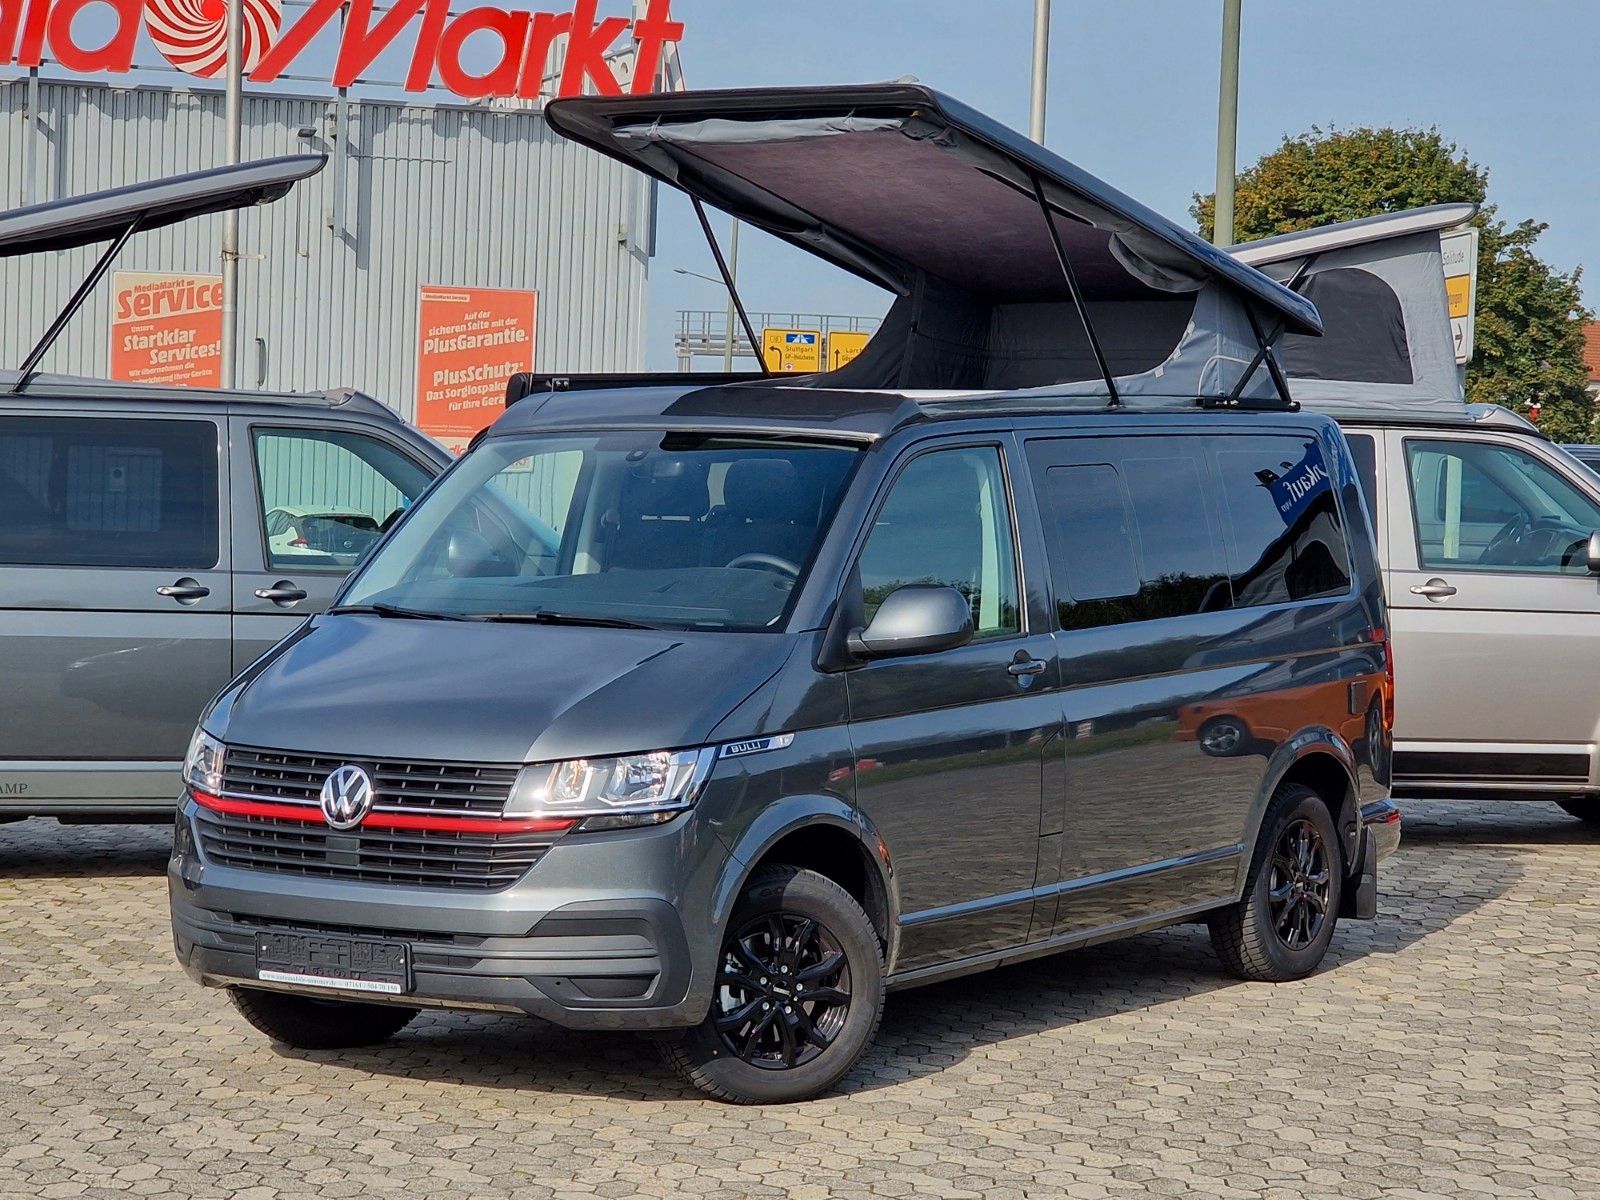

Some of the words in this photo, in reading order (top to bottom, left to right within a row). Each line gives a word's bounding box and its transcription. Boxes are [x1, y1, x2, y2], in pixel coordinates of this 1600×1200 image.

[247, 0, 685, 99] Markt
[134, 280, 185, 294] MediaMarkt
[118, 281, 222, 319] Service
[464, 311, 478, 321] Auf
[478, 311, 491, 319] der
[429, 323, 467, 337] sicheren
[467, 320, 489, 330] Seite
[491, 319, 505, 328] mit
[505, 317, 518, 326] der
[124, 328, 196, 352] Startklar
[423, 327, 529, 355] PlusGarantie.
[150, 340, 221, 365] Services!
[426, 390, 444, 401] Das
[445, 381, 508, 398] Sorglospake
[448, 402, 462, 411] für
[463, 400, 481, 409] Ihre
[482, 395, 506, 407] Gerä
[731, 740, 761, 753] BULLI
